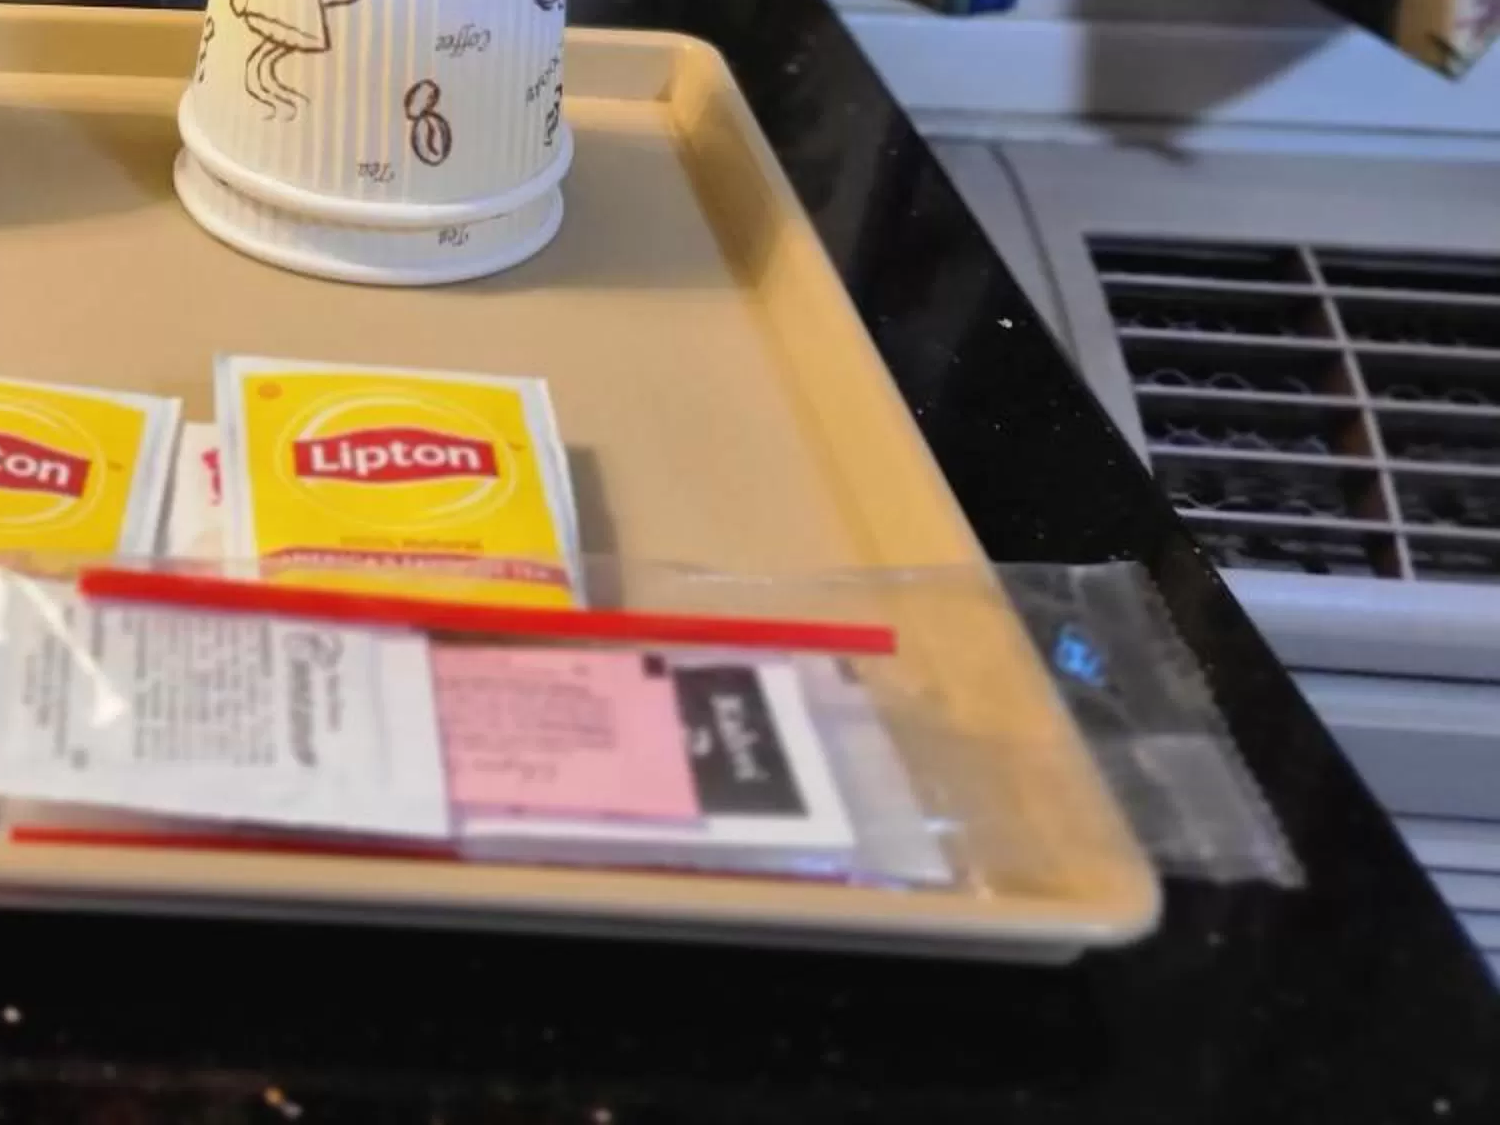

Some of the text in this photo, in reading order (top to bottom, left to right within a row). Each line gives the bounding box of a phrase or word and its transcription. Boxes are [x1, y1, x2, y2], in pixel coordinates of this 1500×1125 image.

[434, 22, 491, 58] Coffee
[357, 162, 395, 184] Tea
[437, 222, 469, 247] Tea
[310, 440, 483, 477] Lipton
